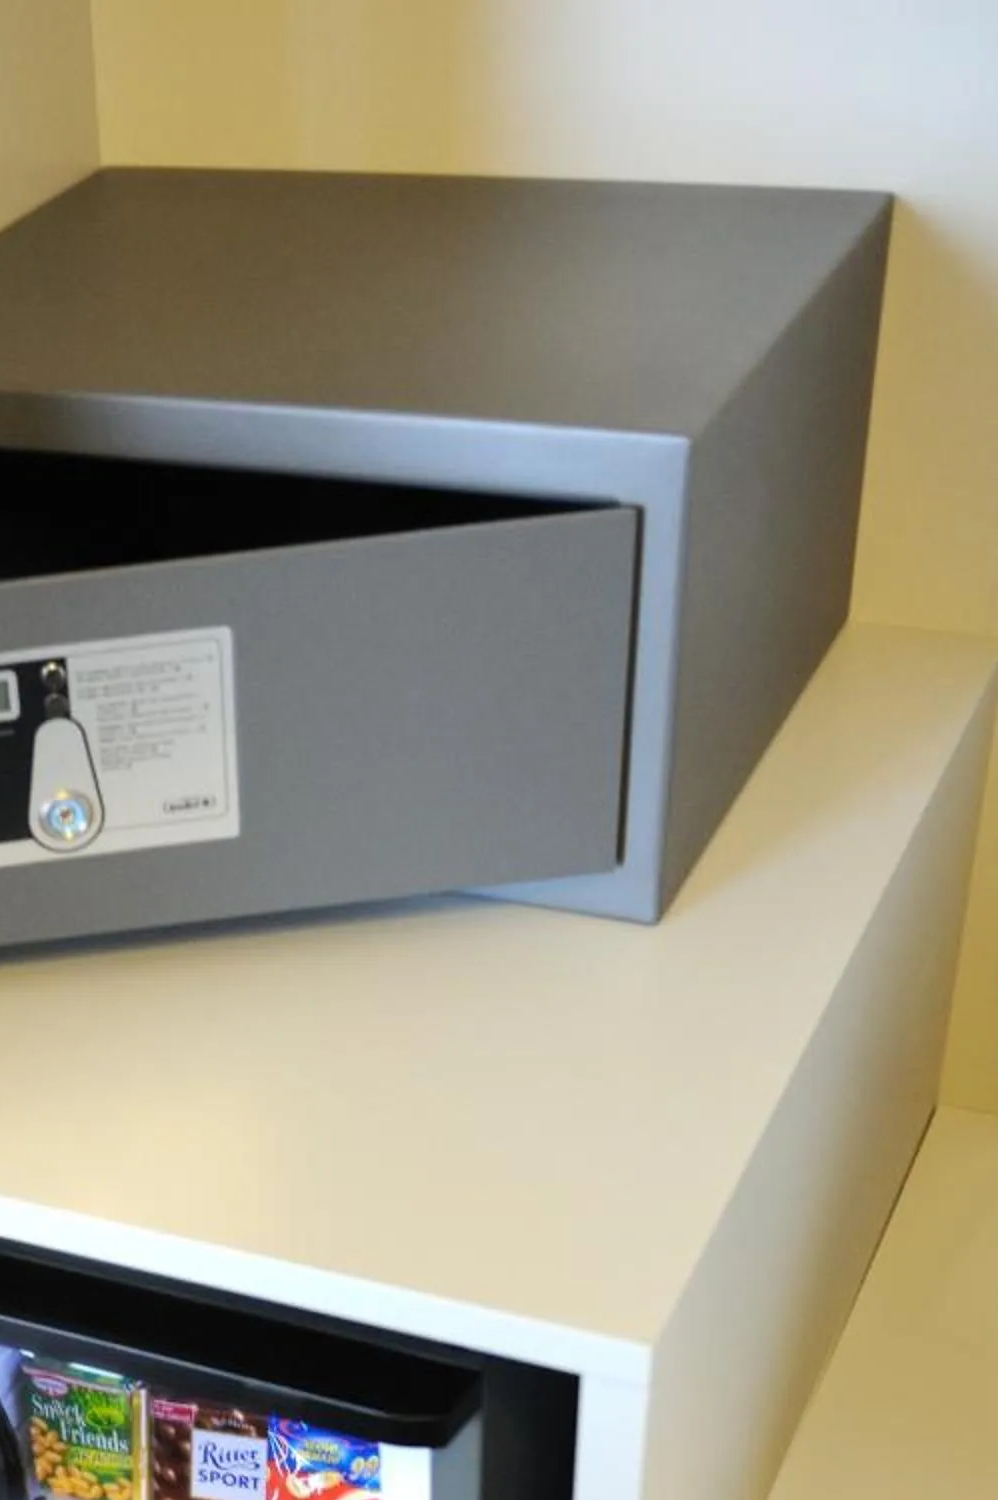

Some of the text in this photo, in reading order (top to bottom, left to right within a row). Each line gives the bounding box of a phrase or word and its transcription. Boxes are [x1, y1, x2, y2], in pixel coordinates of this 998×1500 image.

[60, 1420, 130, 1453] Friends
[199, 1439, 261, 1471] Ritter
[198, 1469, 260, 1491] SPORT
